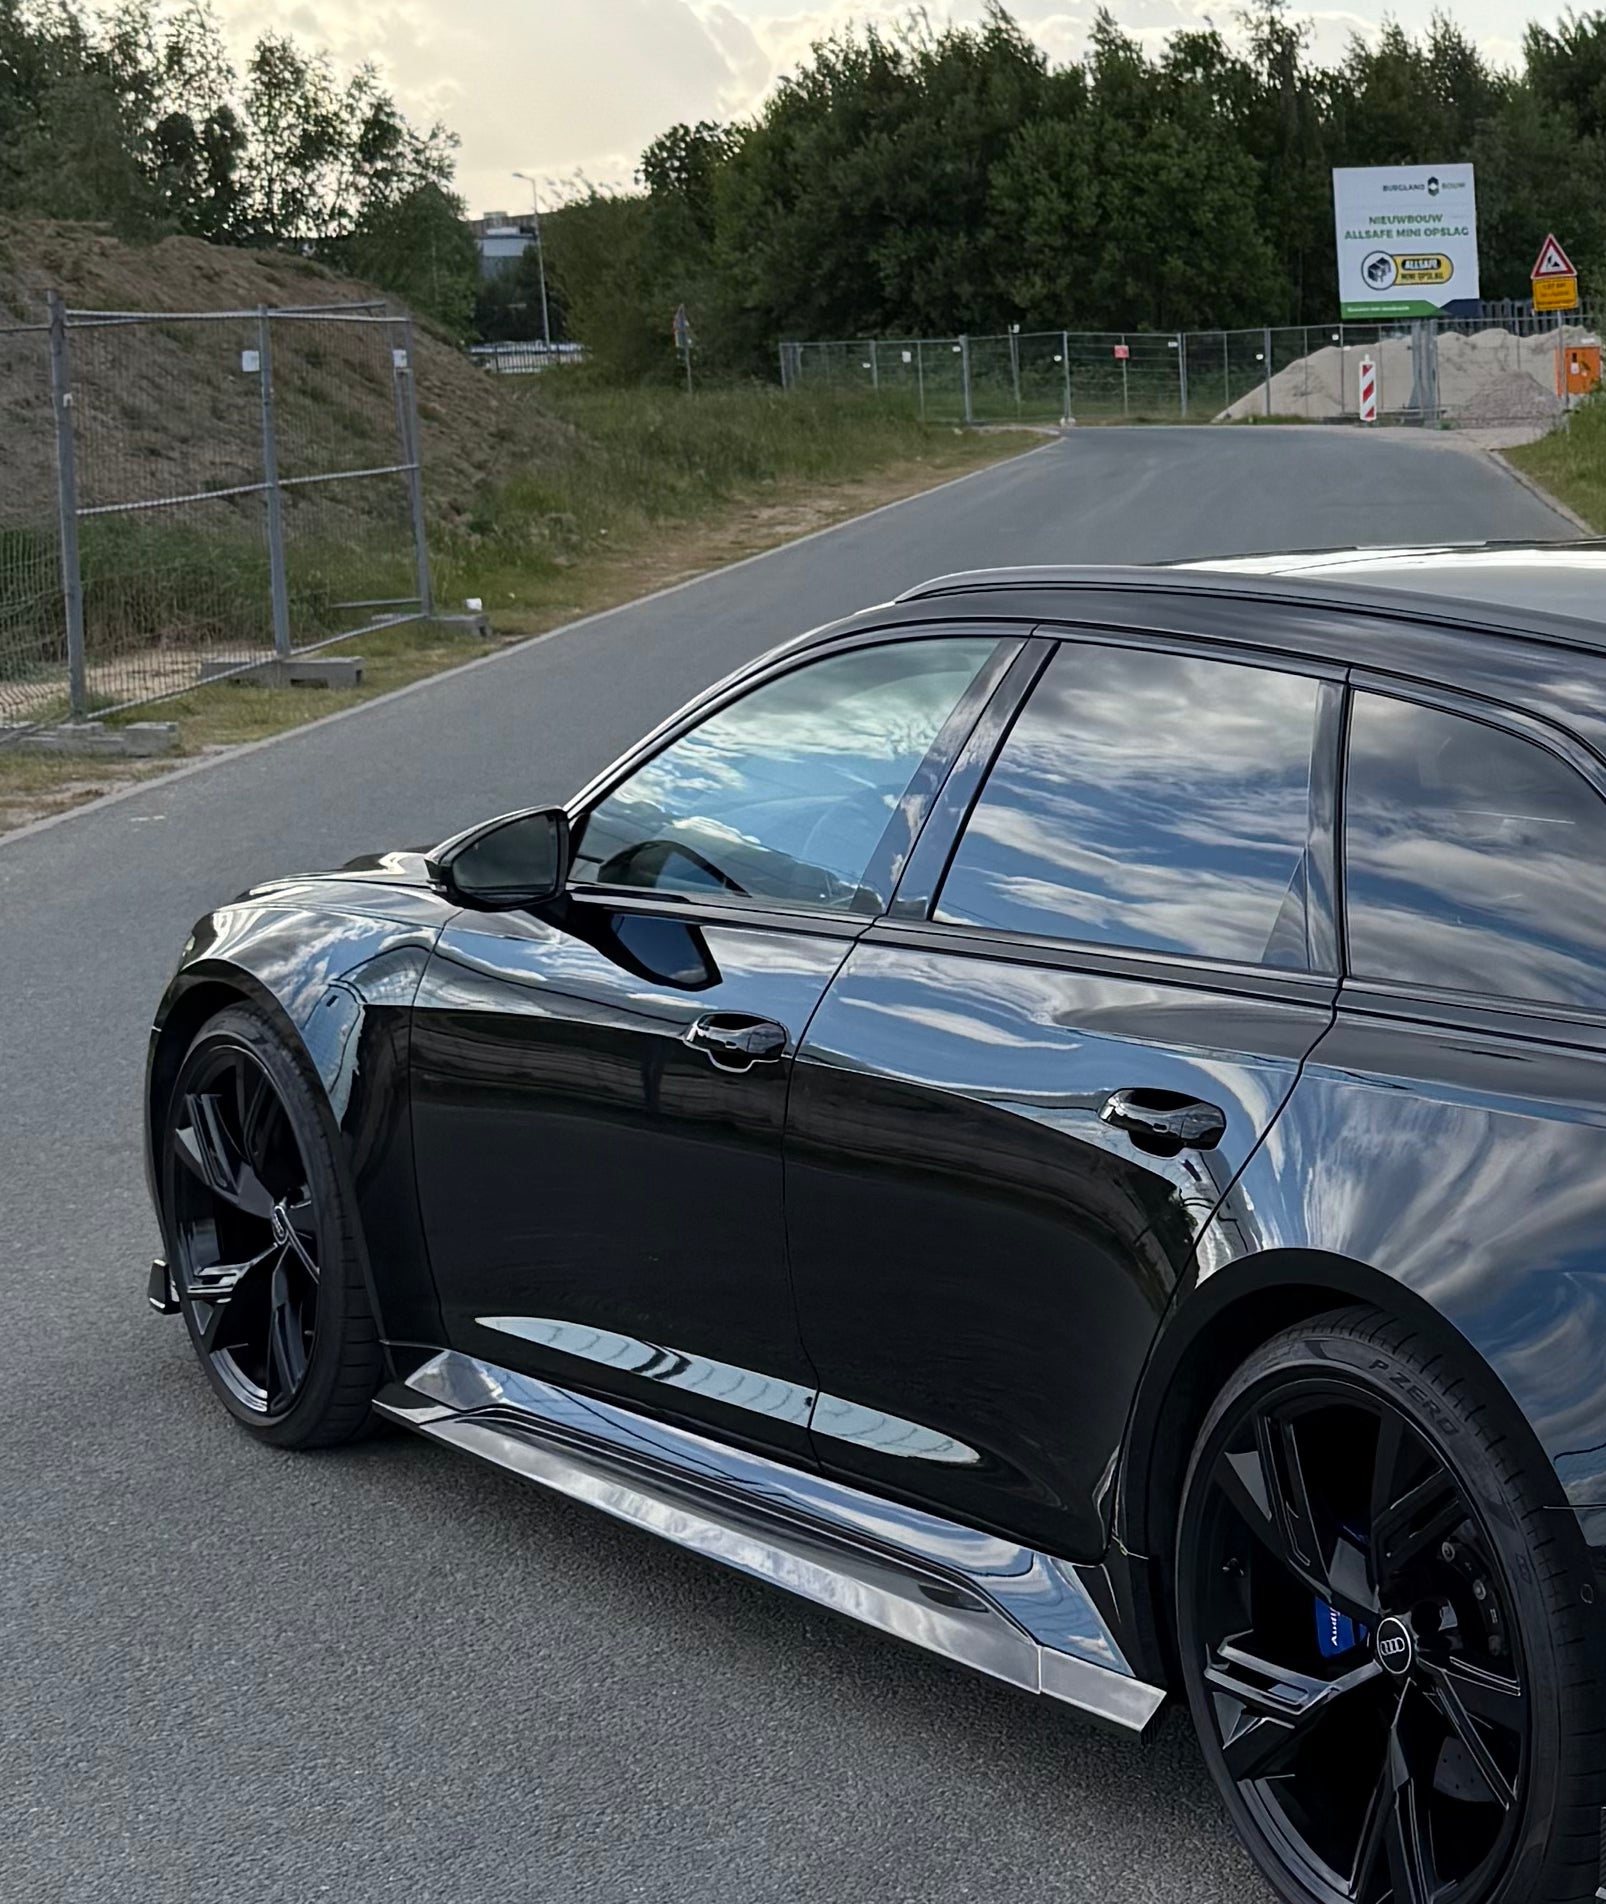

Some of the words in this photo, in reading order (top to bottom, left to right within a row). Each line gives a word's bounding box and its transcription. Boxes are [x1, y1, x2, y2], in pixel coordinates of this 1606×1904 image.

[1369, 213, 1443, 225] NIEUWBOUW
[1344, 229, 1393, 240] ALLSAFE
[1396, 228, 1421, 238] MINI
[1424, 226, 1469, 237] OPSLAG
